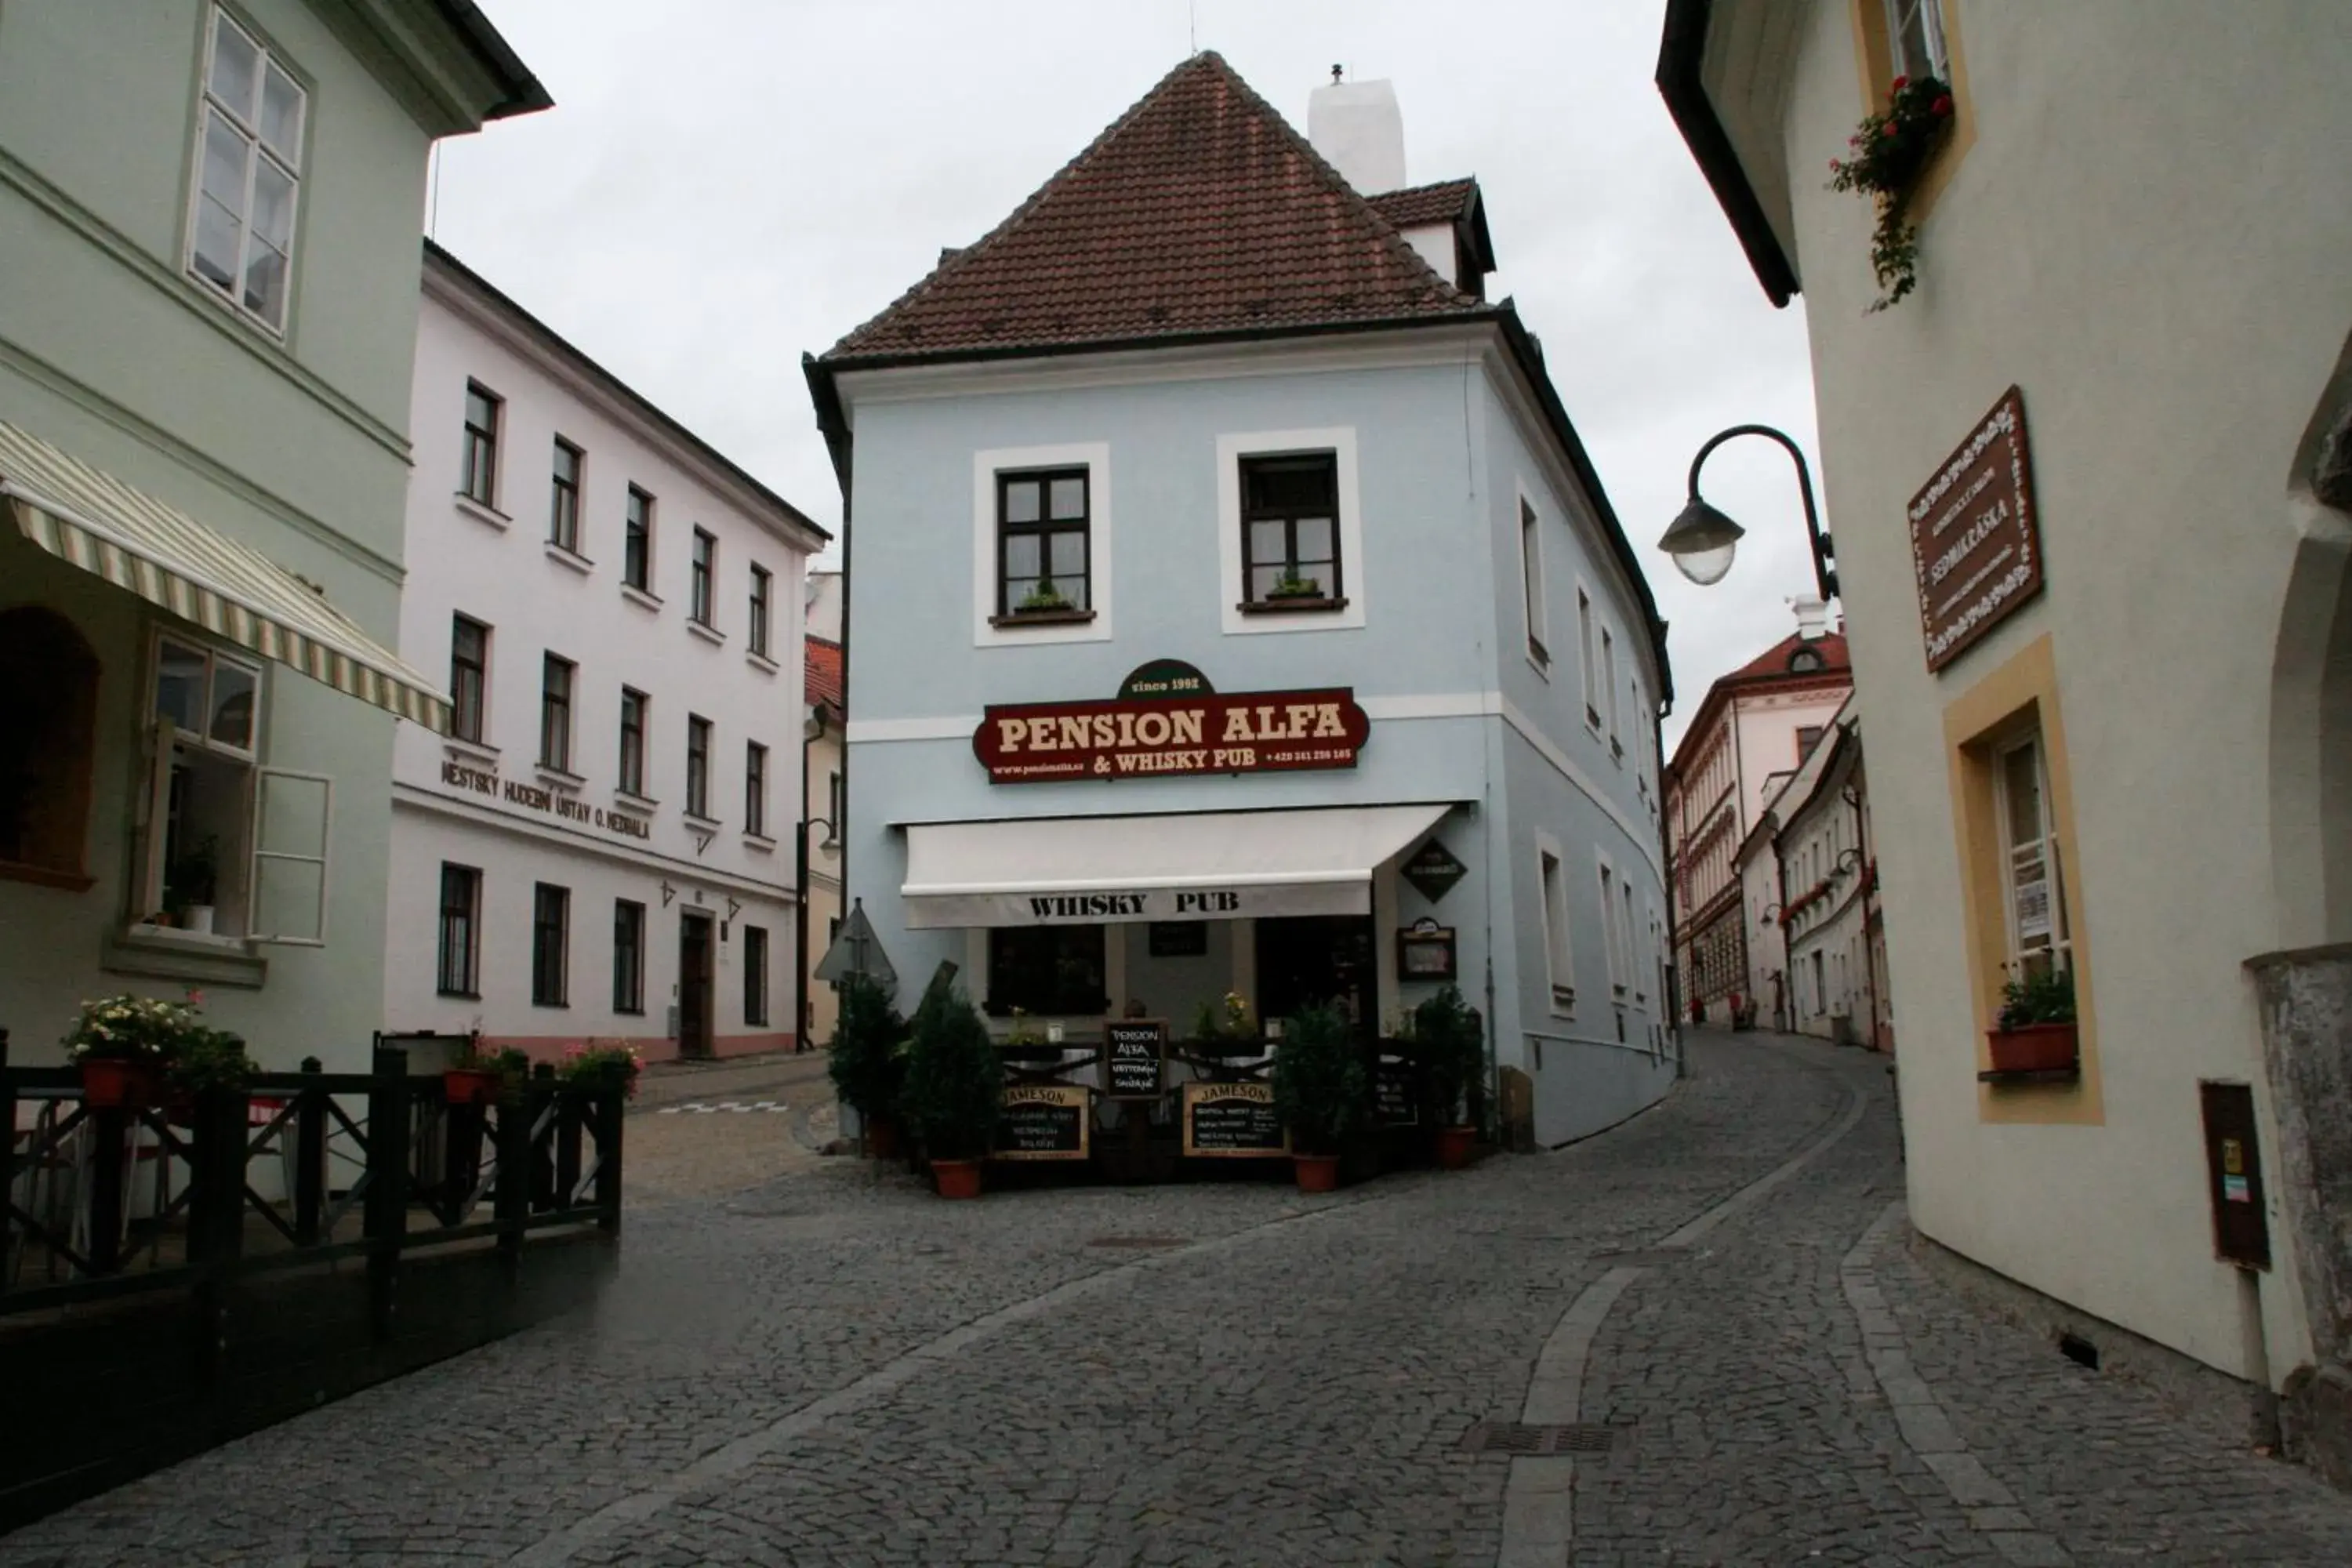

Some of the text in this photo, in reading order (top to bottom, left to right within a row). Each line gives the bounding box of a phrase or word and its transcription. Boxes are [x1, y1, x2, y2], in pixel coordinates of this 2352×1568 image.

[997, 702, 1348, 753] PENSION ALFA
[1093, 748, 1256, 775] & WHISKY PUB
[1029, 891, 1240, 917] WHISKY PUB
[1111, 1029, 1158, 1041] PENSION
[1201, 1084, 1269, 1102] JAMESON
